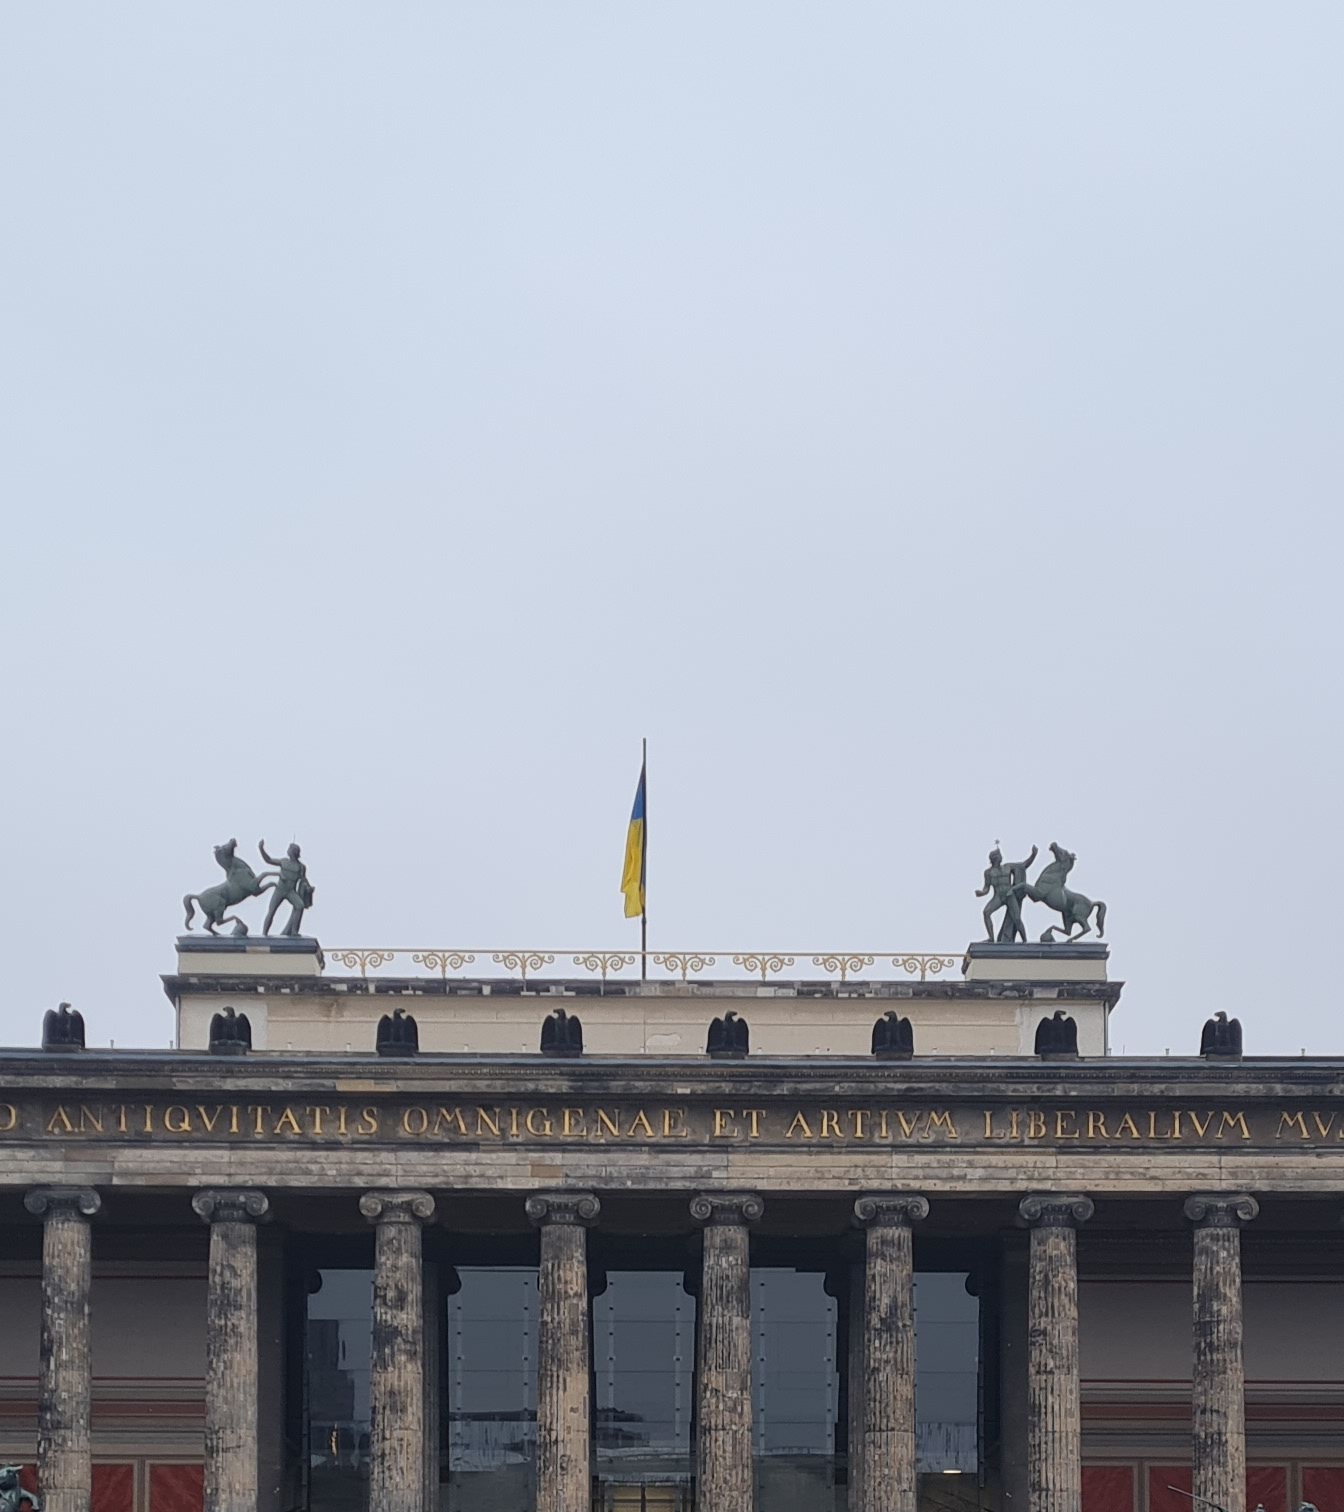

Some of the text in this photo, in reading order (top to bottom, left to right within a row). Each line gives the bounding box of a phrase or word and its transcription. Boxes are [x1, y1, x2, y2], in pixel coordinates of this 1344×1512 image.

[47, 1102, 378, 1135] ANTIQVITATIS
[402, 1105, 687, 1138] OMNIGENAE
[713, 1109, 766, 1138] ET
[785, 1109, 958, 1138] ARTIVM
[982, 1109, 1251, 1140] LIBERALIVM
